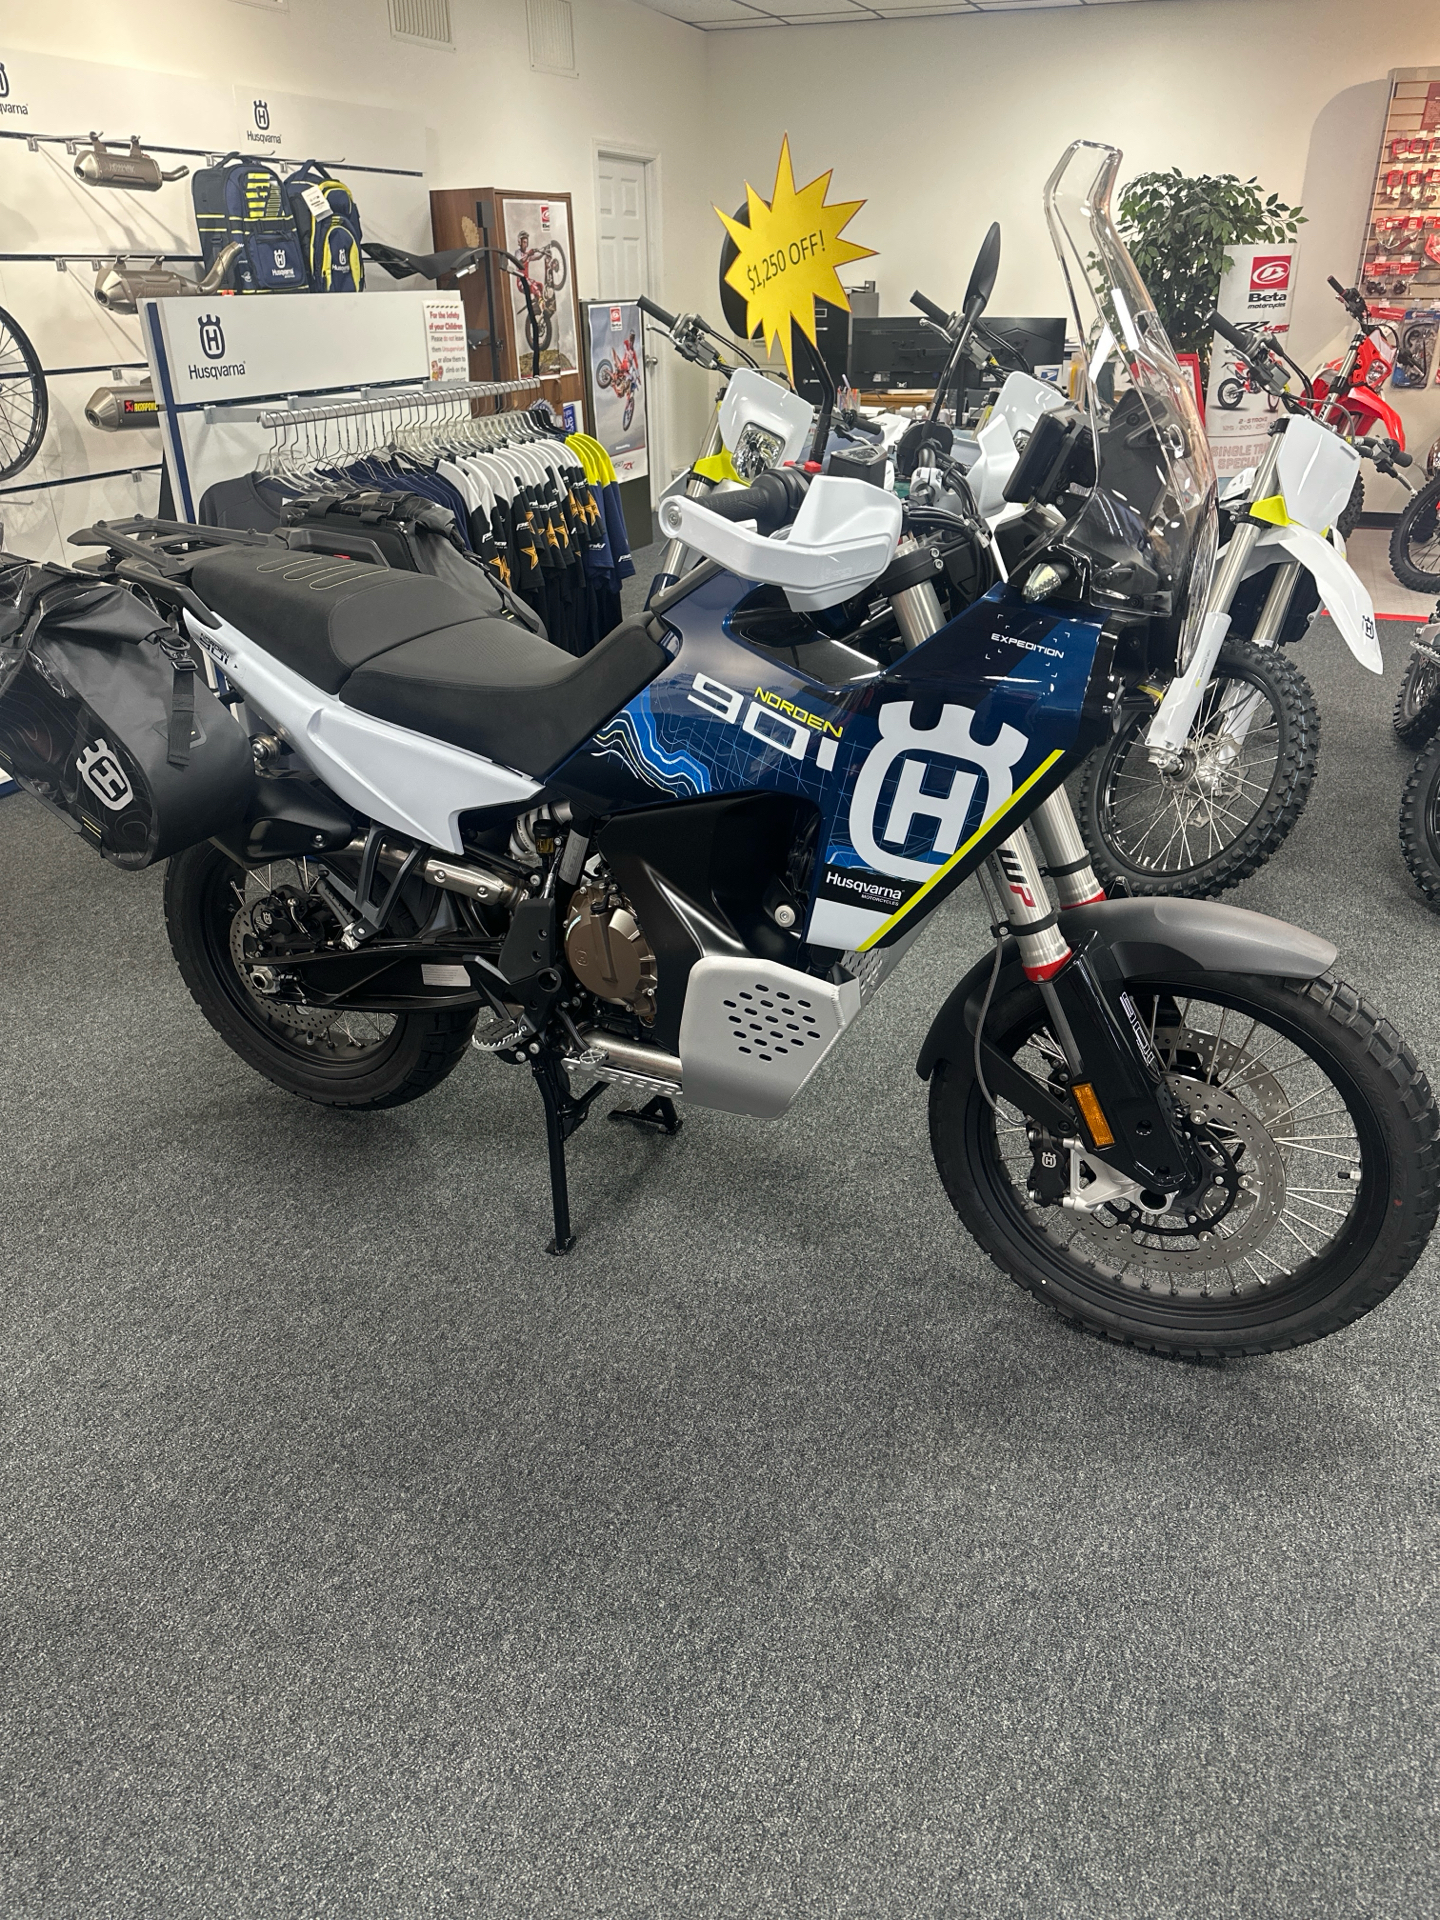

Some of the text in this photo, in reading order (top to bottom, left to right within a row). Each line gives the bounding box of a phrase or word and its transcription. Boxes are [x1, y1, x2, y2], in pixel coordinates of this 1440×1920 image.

[247, 130, 281, 144] Husqvarna
[747, 229, 825, 295] $1,250 OFF!
[1248, 292, 1287, 302] Beta
[429, 311, 460, 320] For the Safety
[434, 324, 445, 332] your
[188, 364, 246, 380] Husqvarna
[1211, 444, 1252, 457] SINGLE
[1218, 456, 1262, 470] SPECIAL
[991, 633, 1065, 659] EXPEDITION
[754, 686, 843, 738] NORDEN
[826, 871, 903, 899] Husqvarna
[861, 894, 899, 907] MOTORCYCLES
